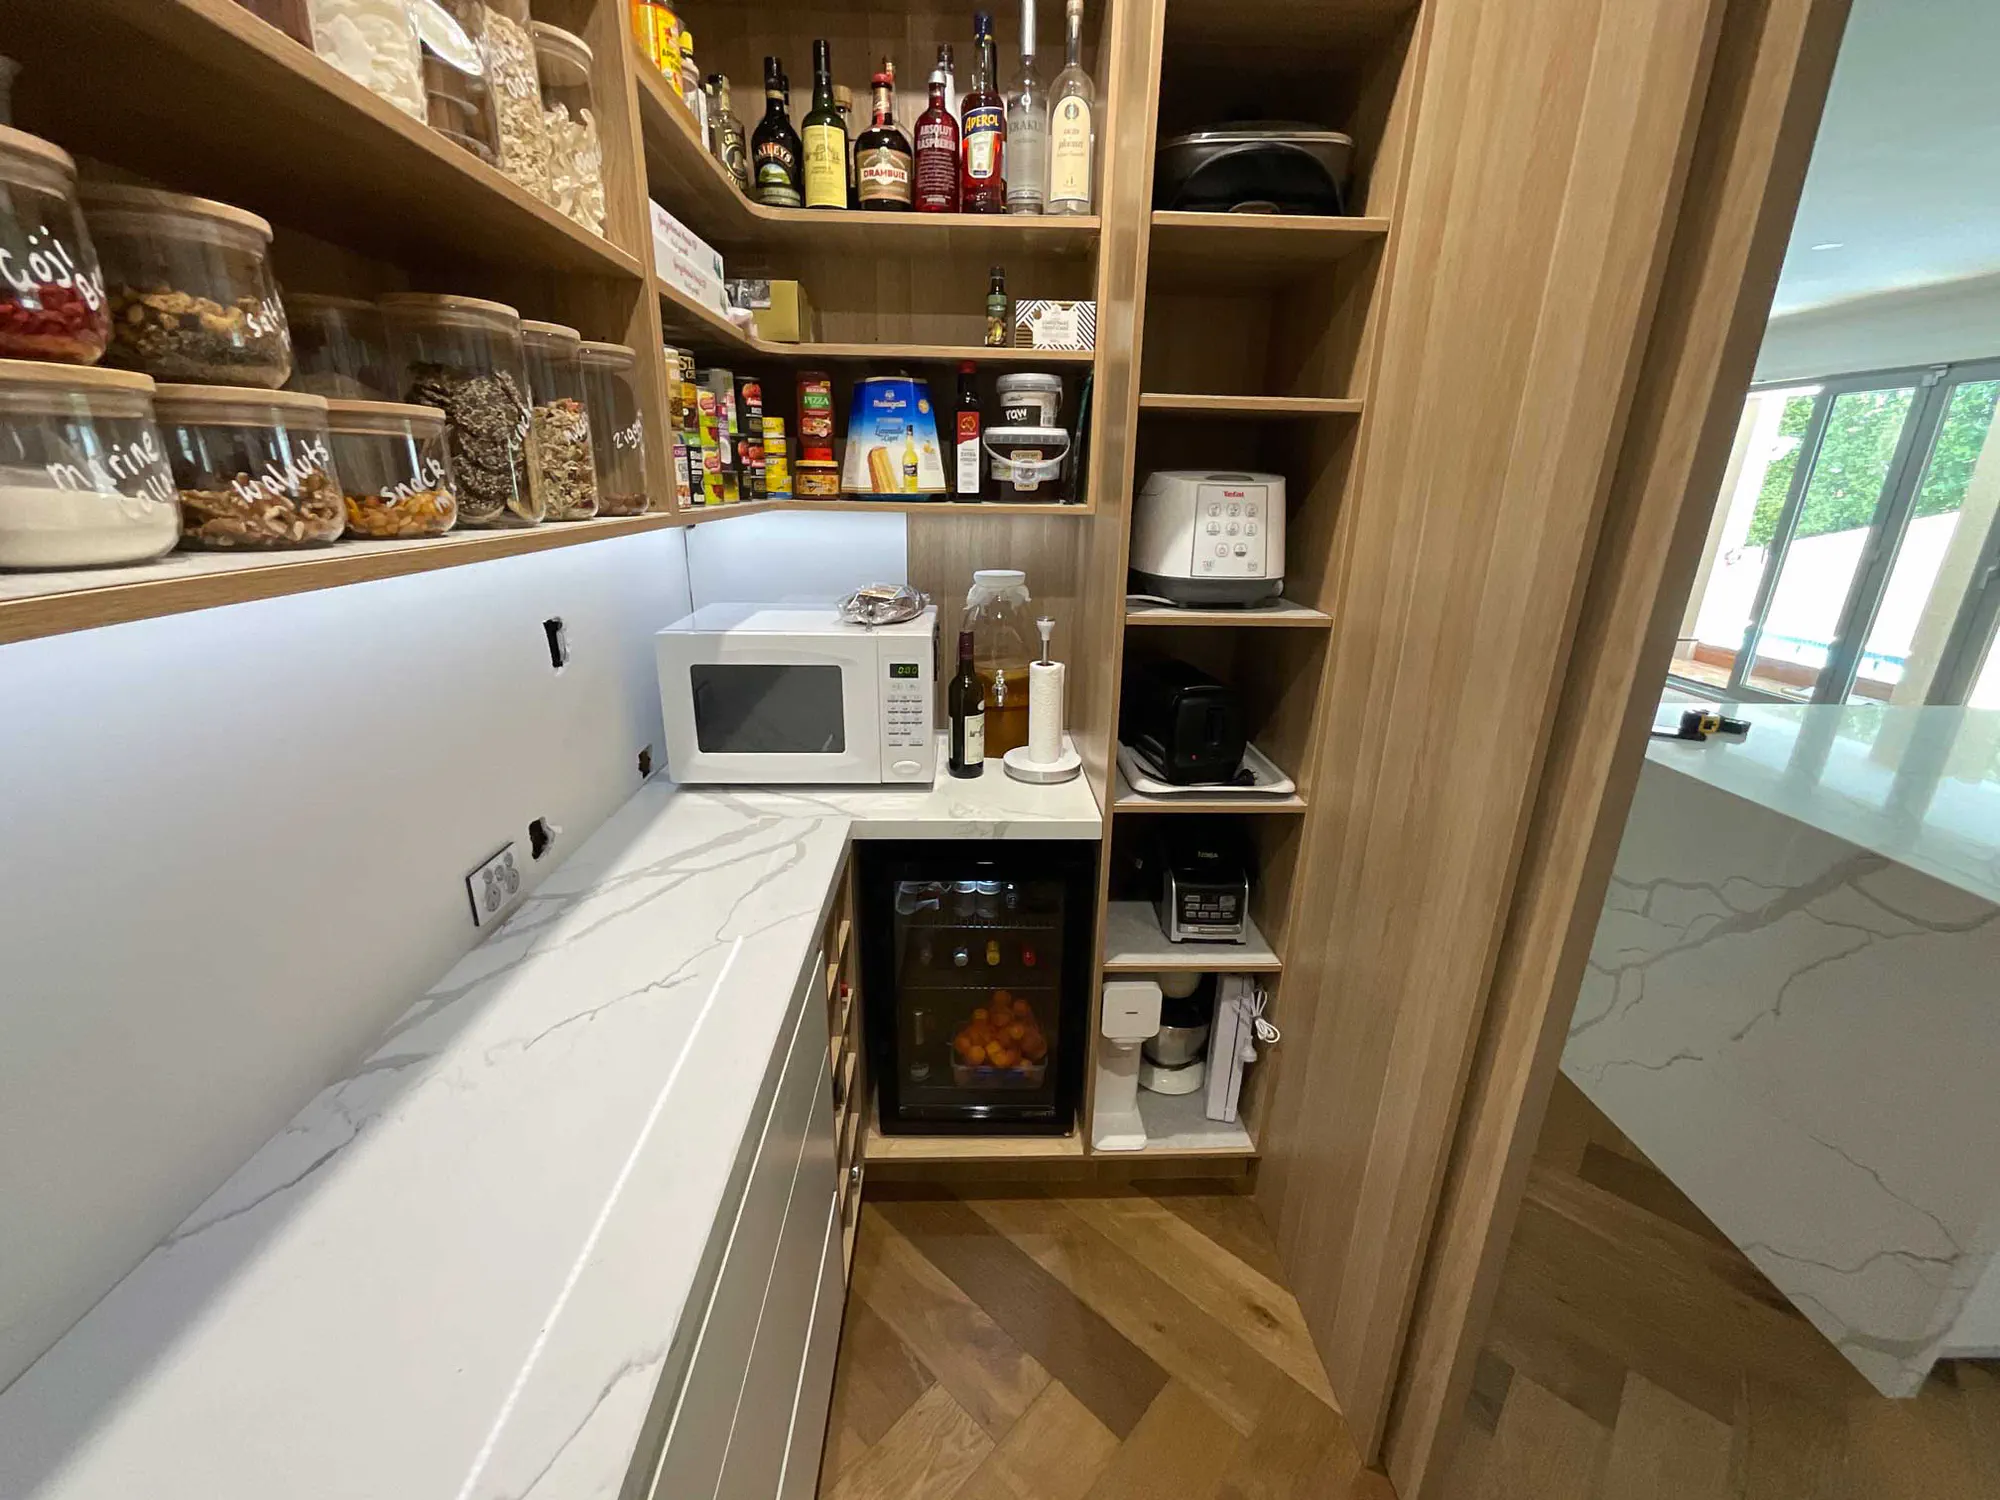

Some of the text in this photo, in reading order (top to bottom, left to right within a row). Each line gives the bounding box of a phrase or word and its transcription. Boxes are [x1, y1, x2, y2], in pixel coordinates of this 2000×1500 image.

[965, 113, 1000, 132] APEROL
[920, 124, 953, 137] ABSOLUT
[863, 168, 906, 181] DRAMBUIE
[803, 395, 830, 406] PIZZA
[1005, 407, 1028, 421] raw
[231, 438, 330, 504] walnuts
[378, 456, 446, 509] snack
